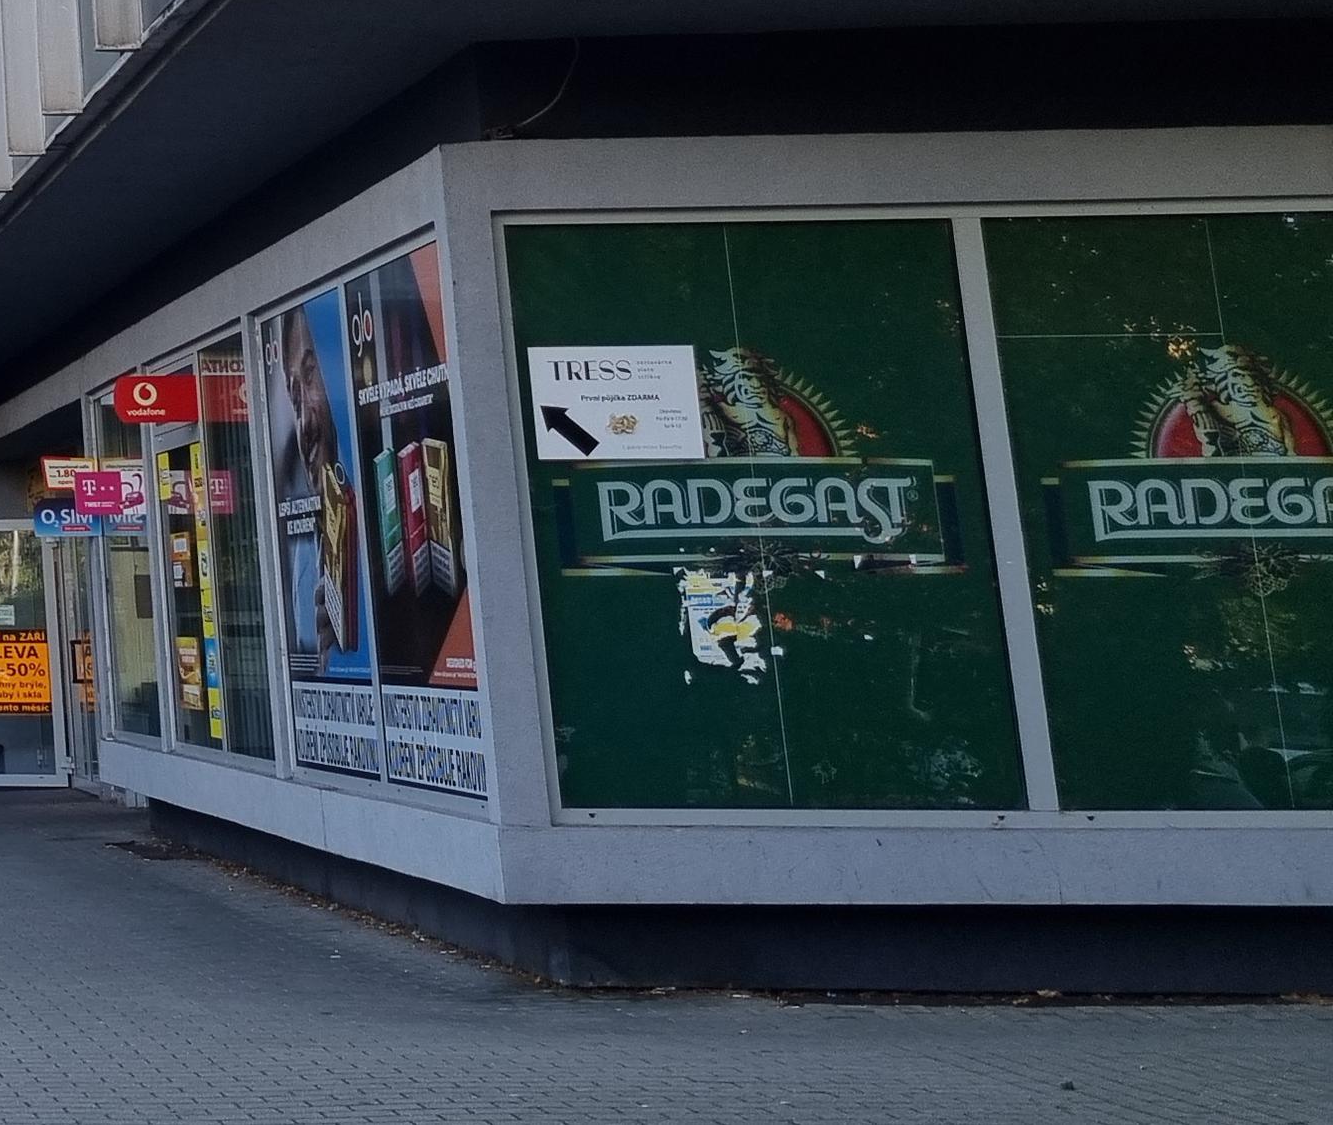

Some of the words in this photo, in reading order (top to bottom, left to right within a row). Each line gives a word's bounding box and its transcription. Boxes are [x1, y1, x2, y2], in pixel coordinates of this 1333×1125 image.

[351, 290, 373, 358] glo
[547, 359, 633, 381] TRESS
[126, 407, 166, 417] vodafone
[596, 477, 917, 545] RADEGAST
[2, 634, 16, 642] na
[23, 689, 42, 699] skla
[24, 701, 50, 712] měsíc
